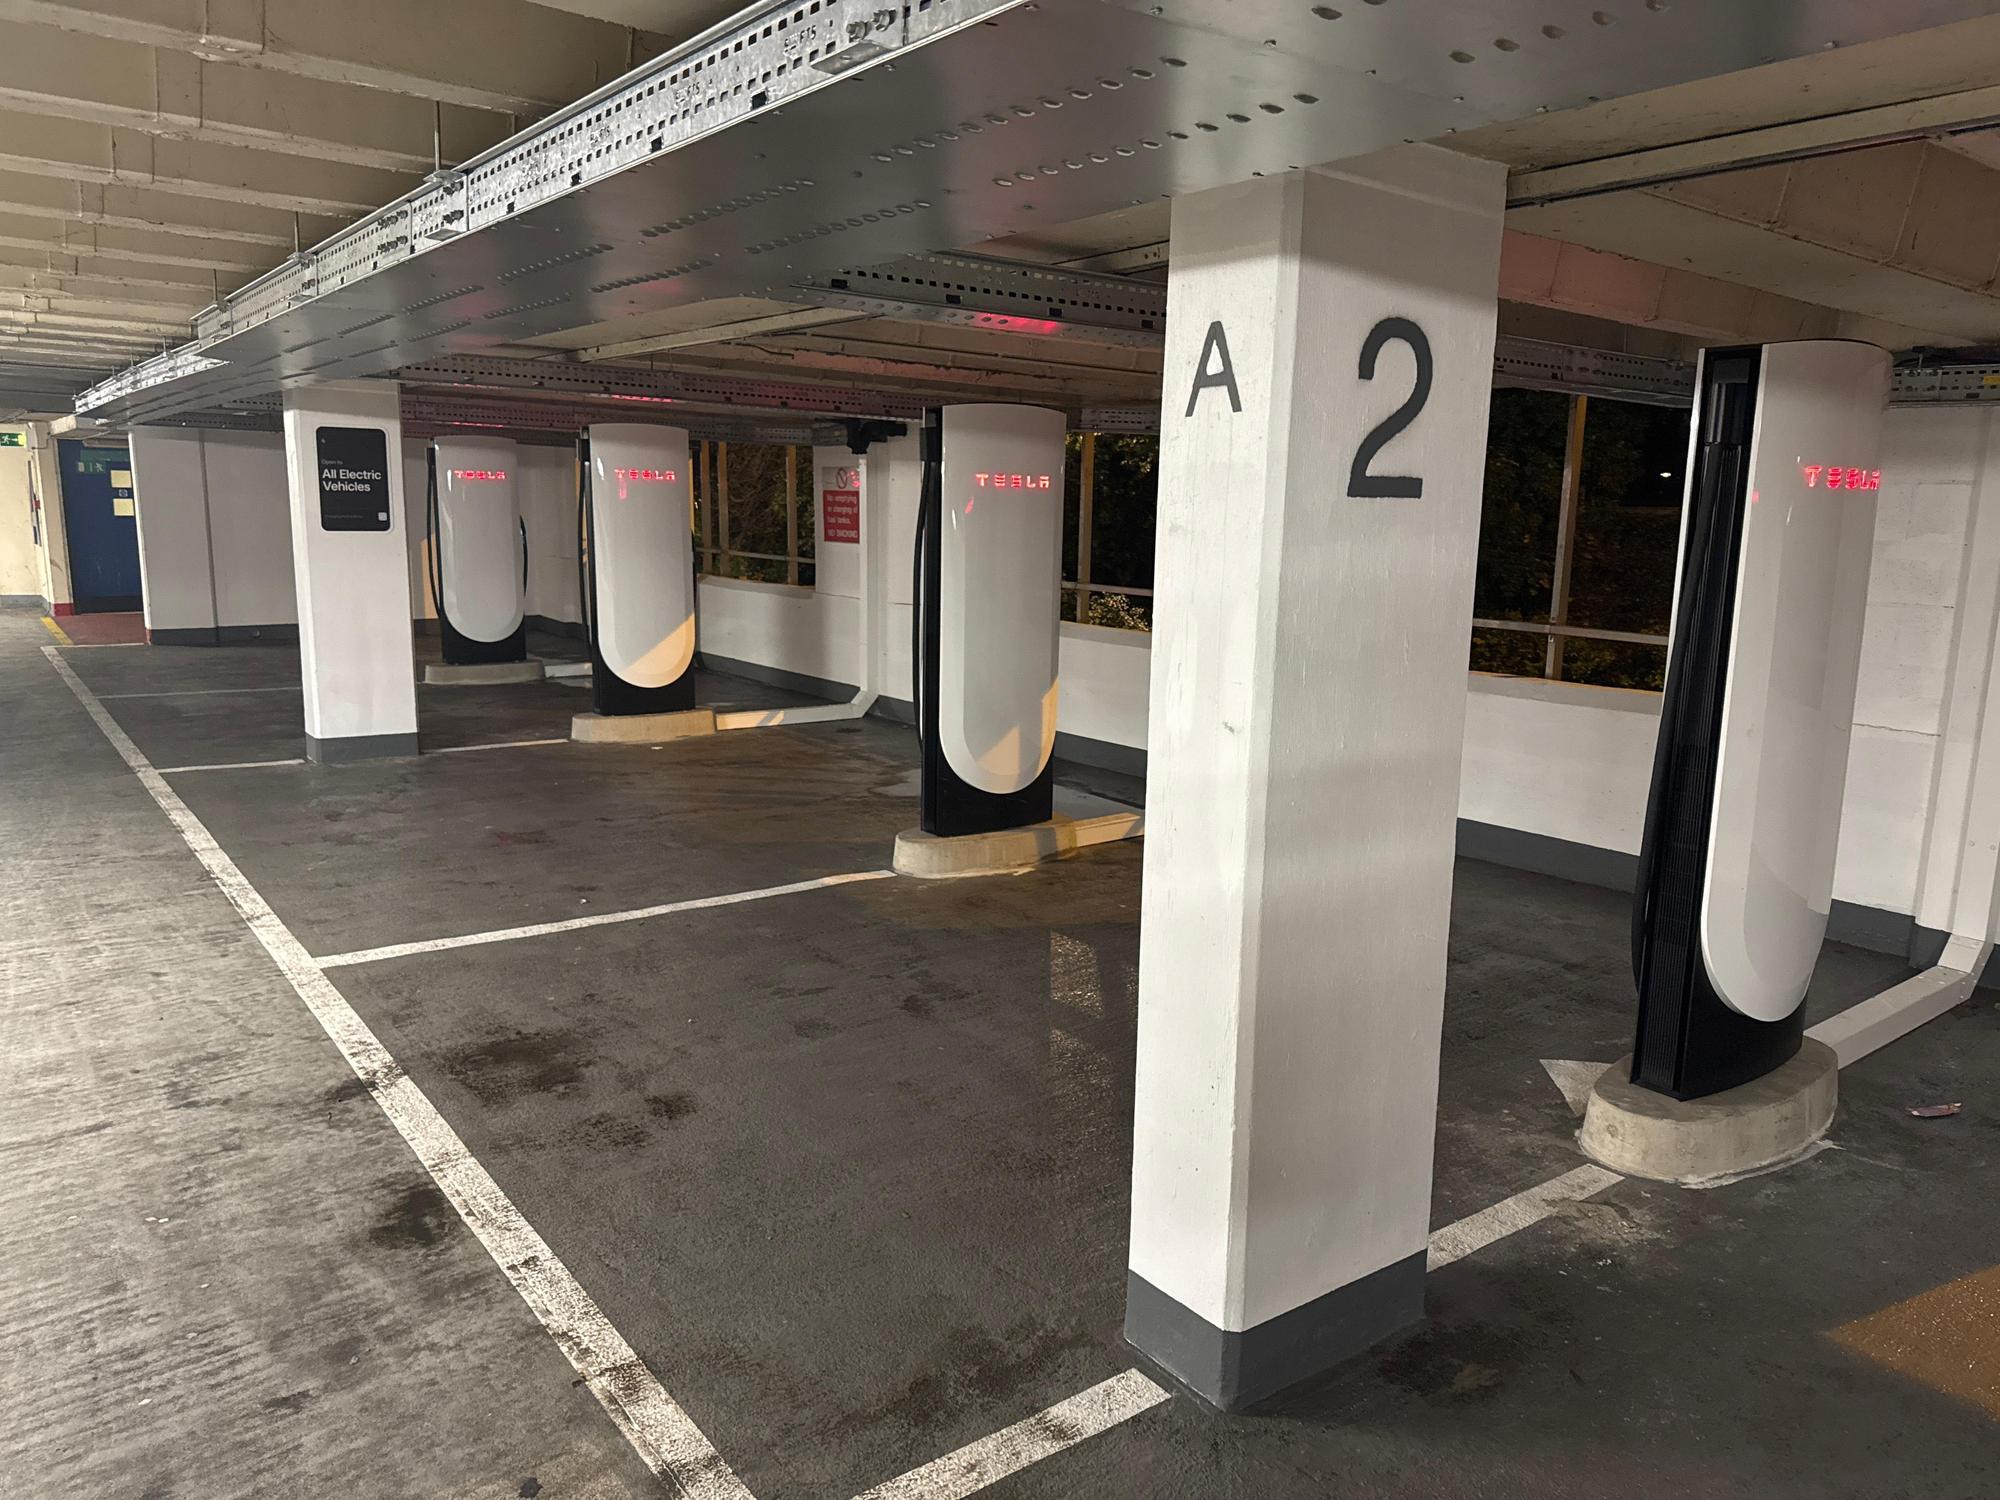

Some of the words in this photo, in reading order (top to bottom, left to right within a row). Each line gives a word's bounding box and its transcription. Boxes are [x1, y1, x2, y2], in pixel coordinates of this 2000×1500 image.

[1185, 320, 1242, 417] A
[1347, 316, 1433, 499] 2
[322, 468, 337, 479] All
[339, 469, 382, 480] Electric
[453, 469, 506, 480] TESLA
[614, 468, 676, 481] TESLA
[975, 473, 1050, 489] TESLA
[1804, 465, 1880, 490] TESLA
[322, 480, 371, 492] Vehicles
